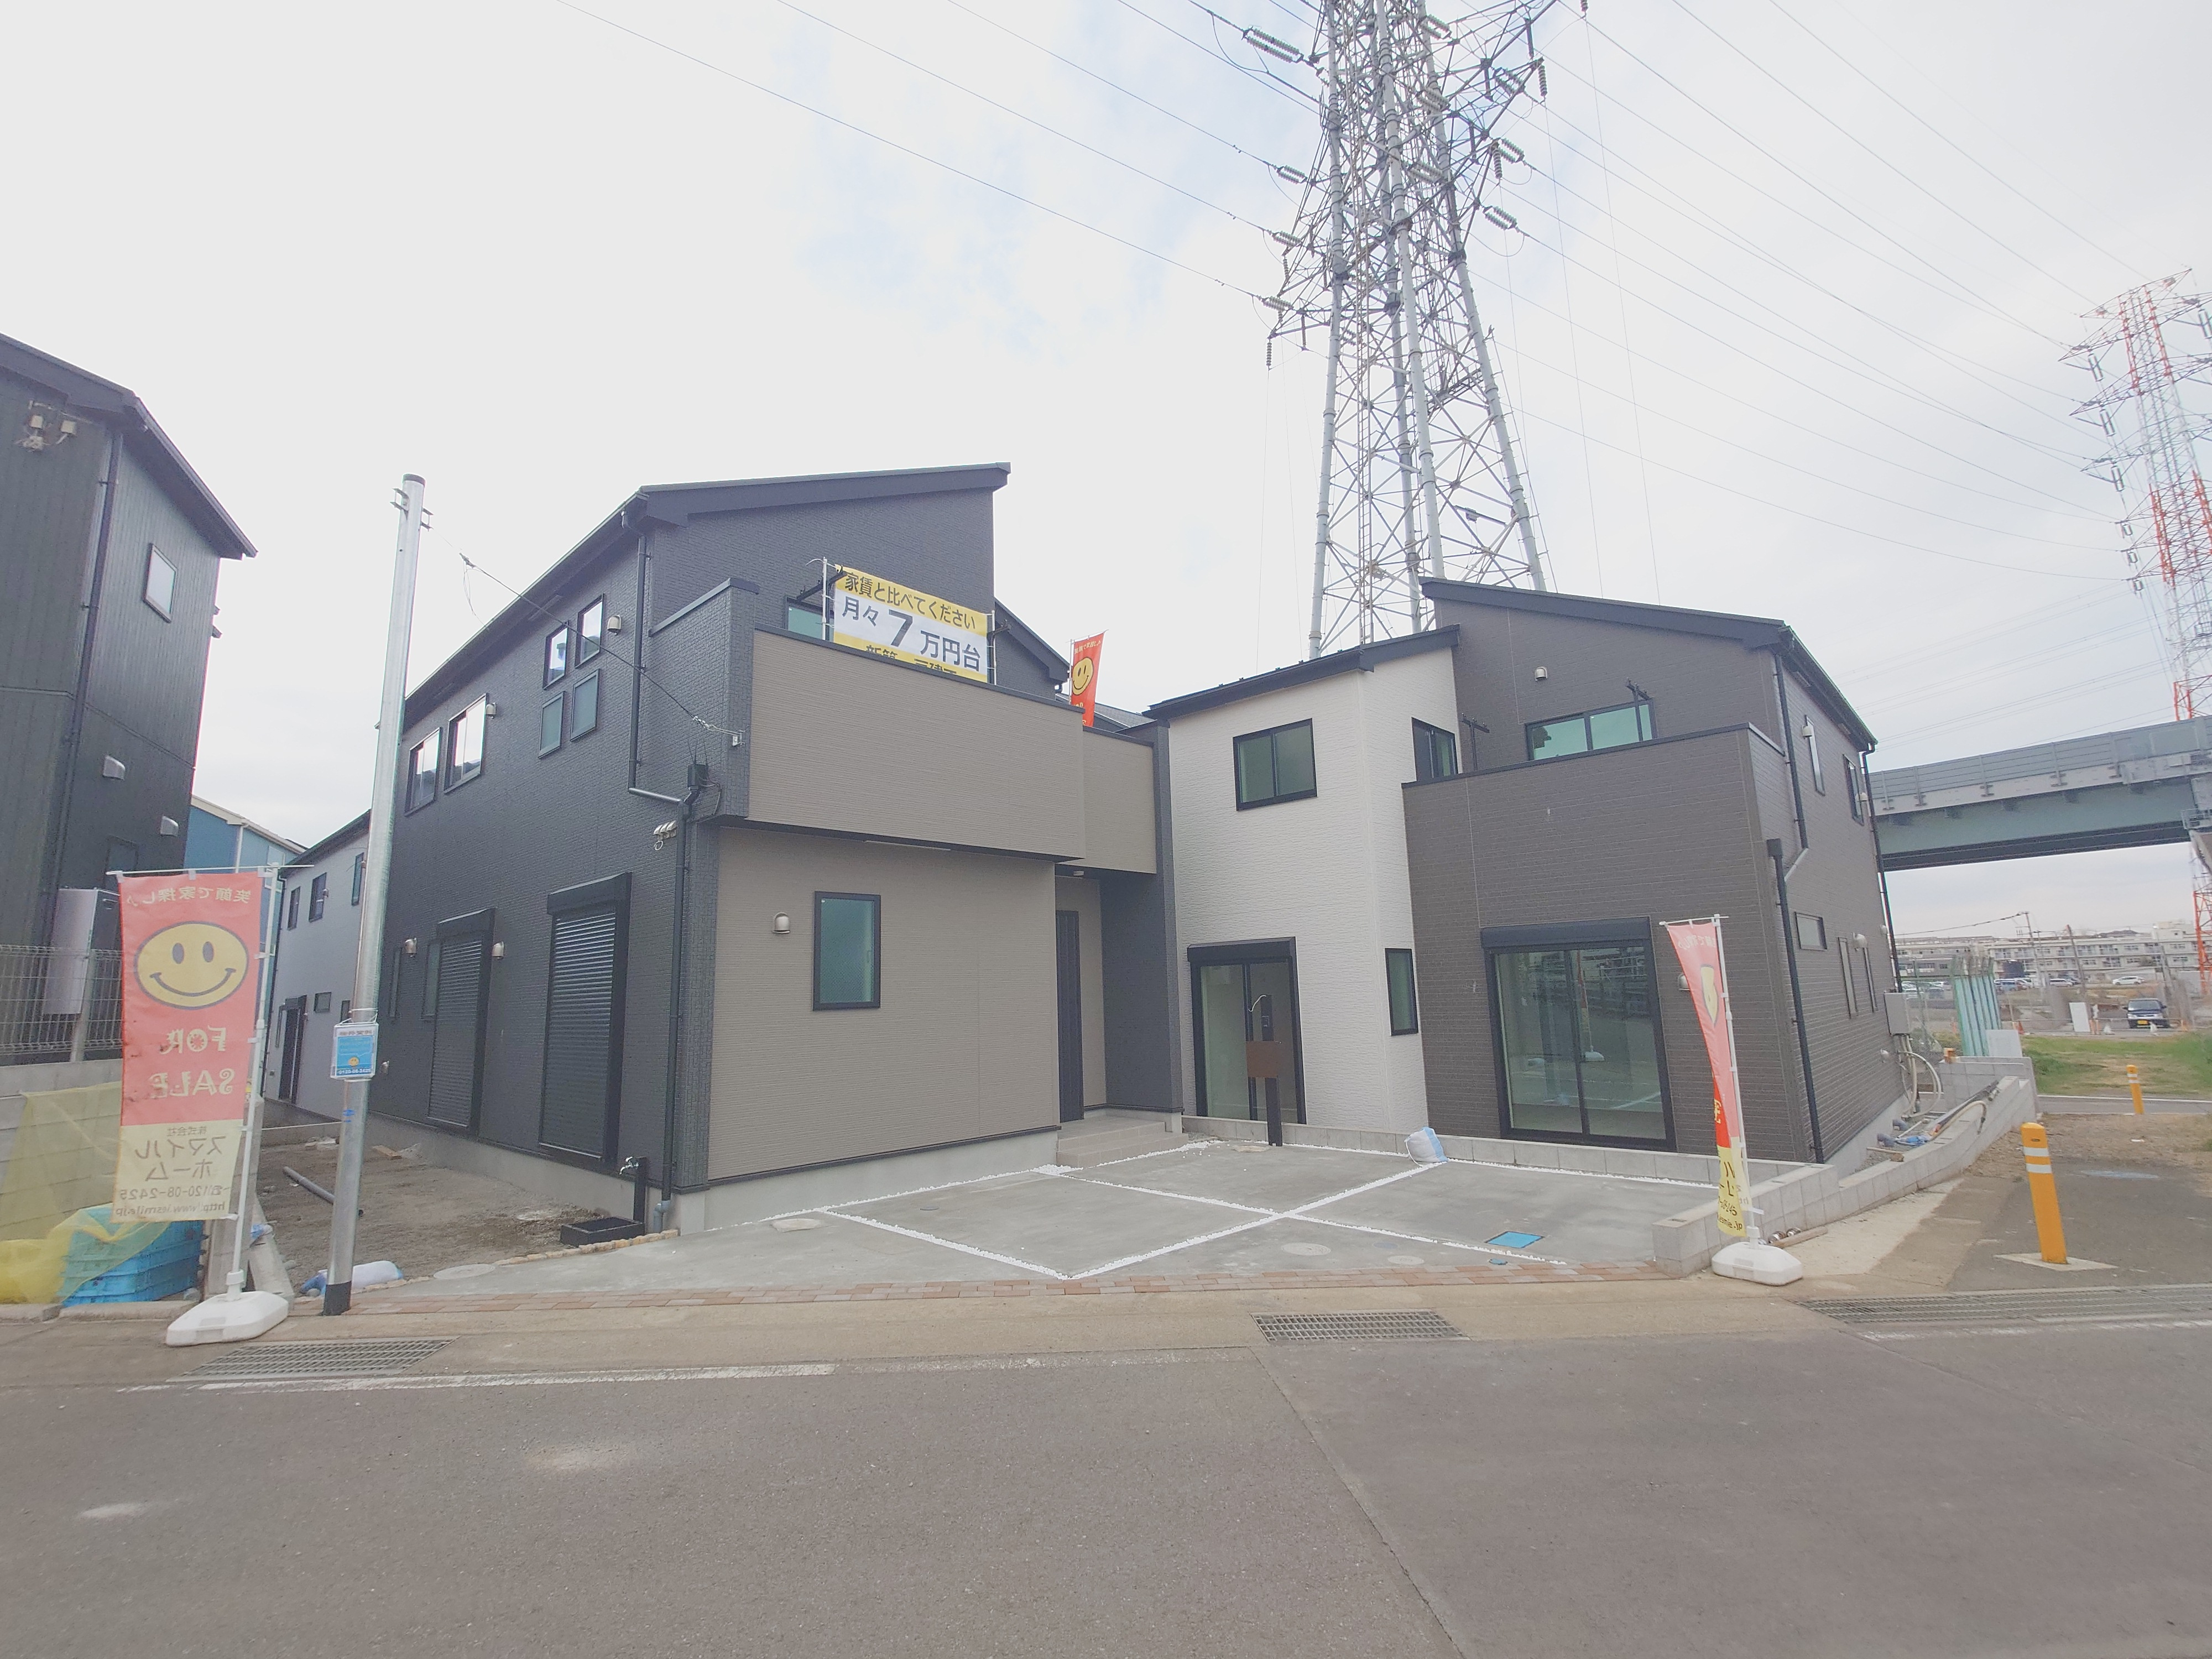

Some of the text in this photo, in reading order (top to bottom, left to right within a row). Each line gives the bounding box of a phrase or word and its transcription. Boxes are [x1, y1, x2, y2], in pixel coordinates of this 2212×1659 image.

[844, 572, 975, 629] 家賃と比べてください
